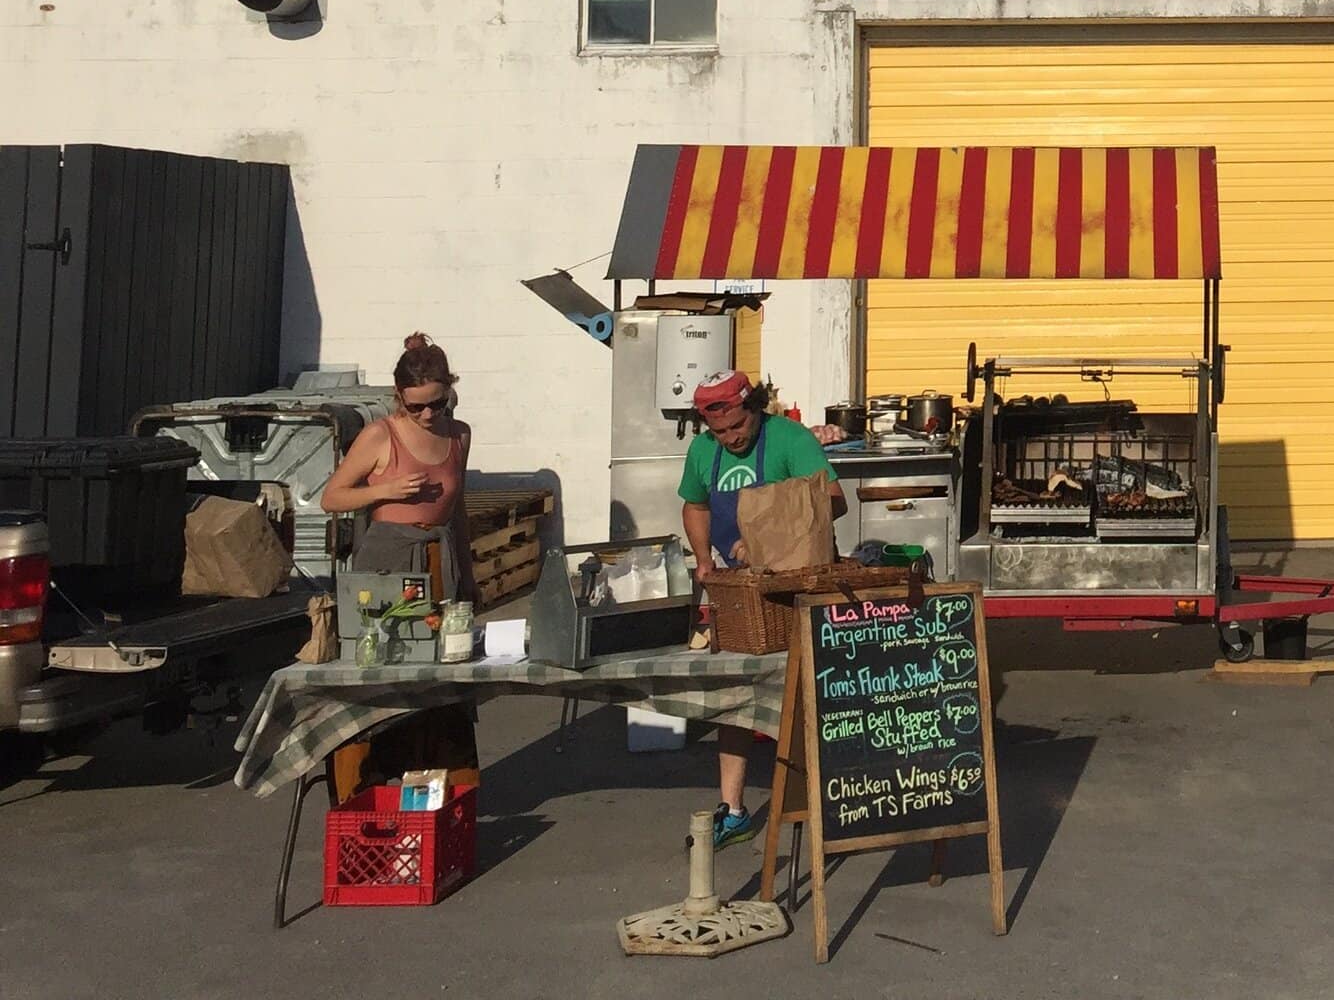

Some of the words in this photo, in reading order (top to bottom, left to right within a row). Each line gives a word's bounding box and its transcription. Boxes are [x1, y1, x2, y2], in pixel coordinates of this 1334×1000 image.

[831, 604, 859, 622] La
[863, 601, 910, 622] Pampa
[821, 618, 908, 659] Argentine
[914, 612, 948, 638] Sub
[940, 648, 975, 674] $9.00
[816, 666, 856, 698] Tom's
[857, 666, 900, 696] Flank
[904, 658, 945, 689] Steak
[963, 680, 978, 689] rice
[822, 716, 864, 742] Grilled
[867, 711, 892, 730] Bell
[895, 706, 941, 730] Peppers
[871, 722, 942, 748] Stuffed
[938, 737, 957, 747] rice
[828, 774, 891, 800] Chicken
[896, 765, 946, 790] Wings
[838, 803, 869, 826] from
[872, 795, 899, 818] TS
[902, 790, 953, 815] Farms
